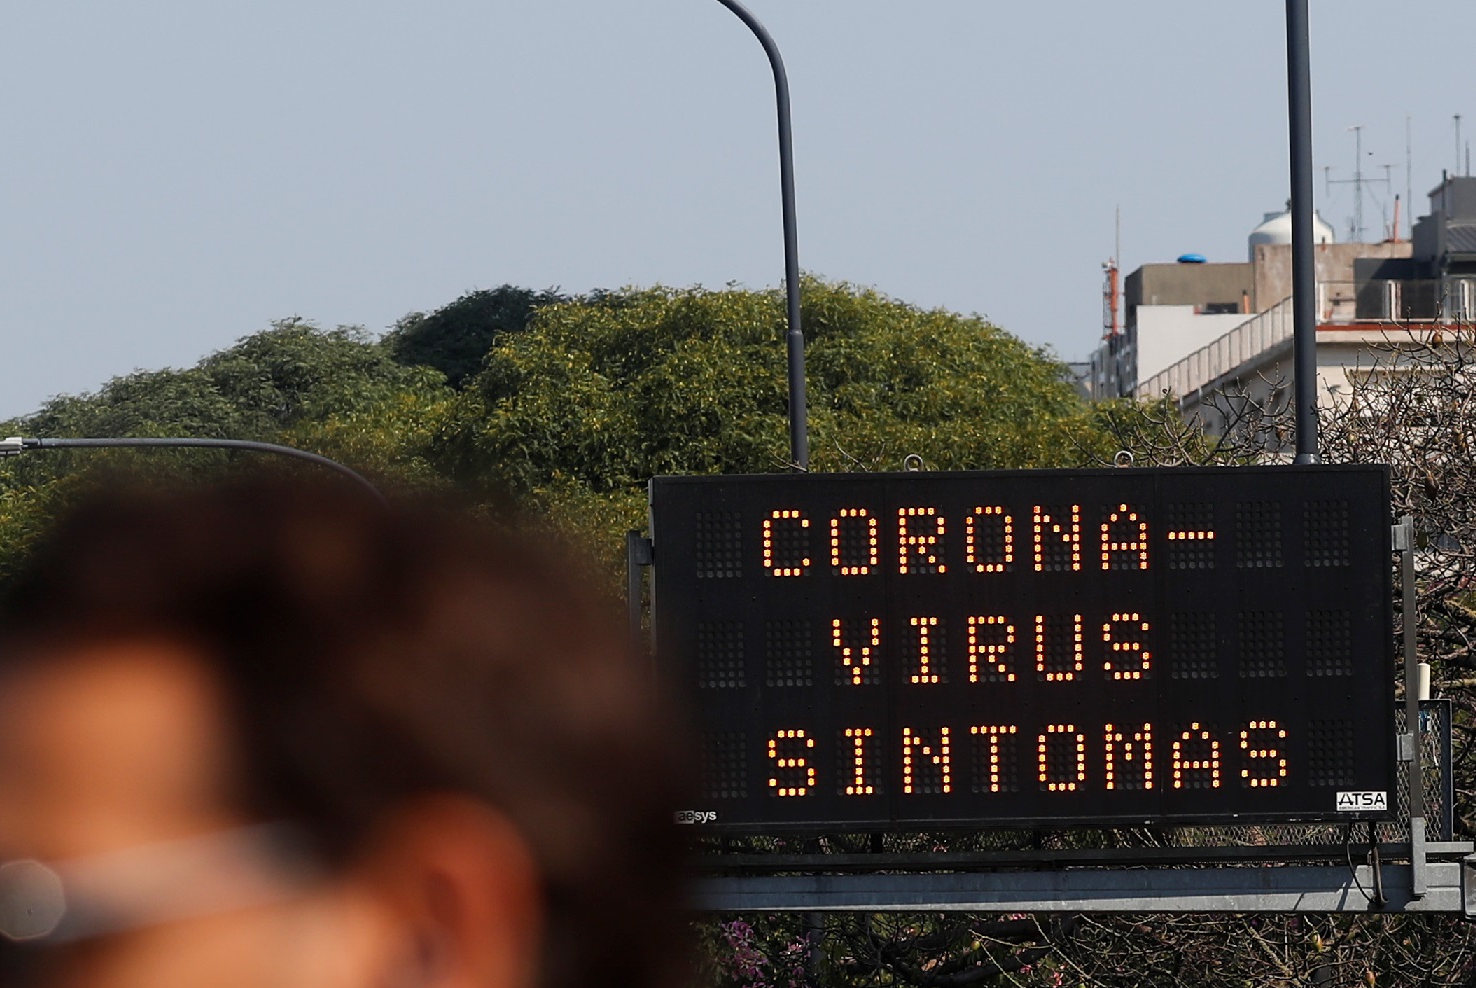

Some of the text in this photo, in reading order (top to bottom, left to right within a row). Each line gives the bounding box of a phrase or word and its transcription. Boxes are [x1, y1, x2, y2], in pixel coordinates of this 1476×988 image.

[762, 503, 1215, 577] CORONA-
[831, 612, 1151, 685] VIRUS
[767, 720, 1289, 797] SINTOMAS
[678, 811, 717, 824] aesys
[1338, 793, 1385, 806] ATSA
